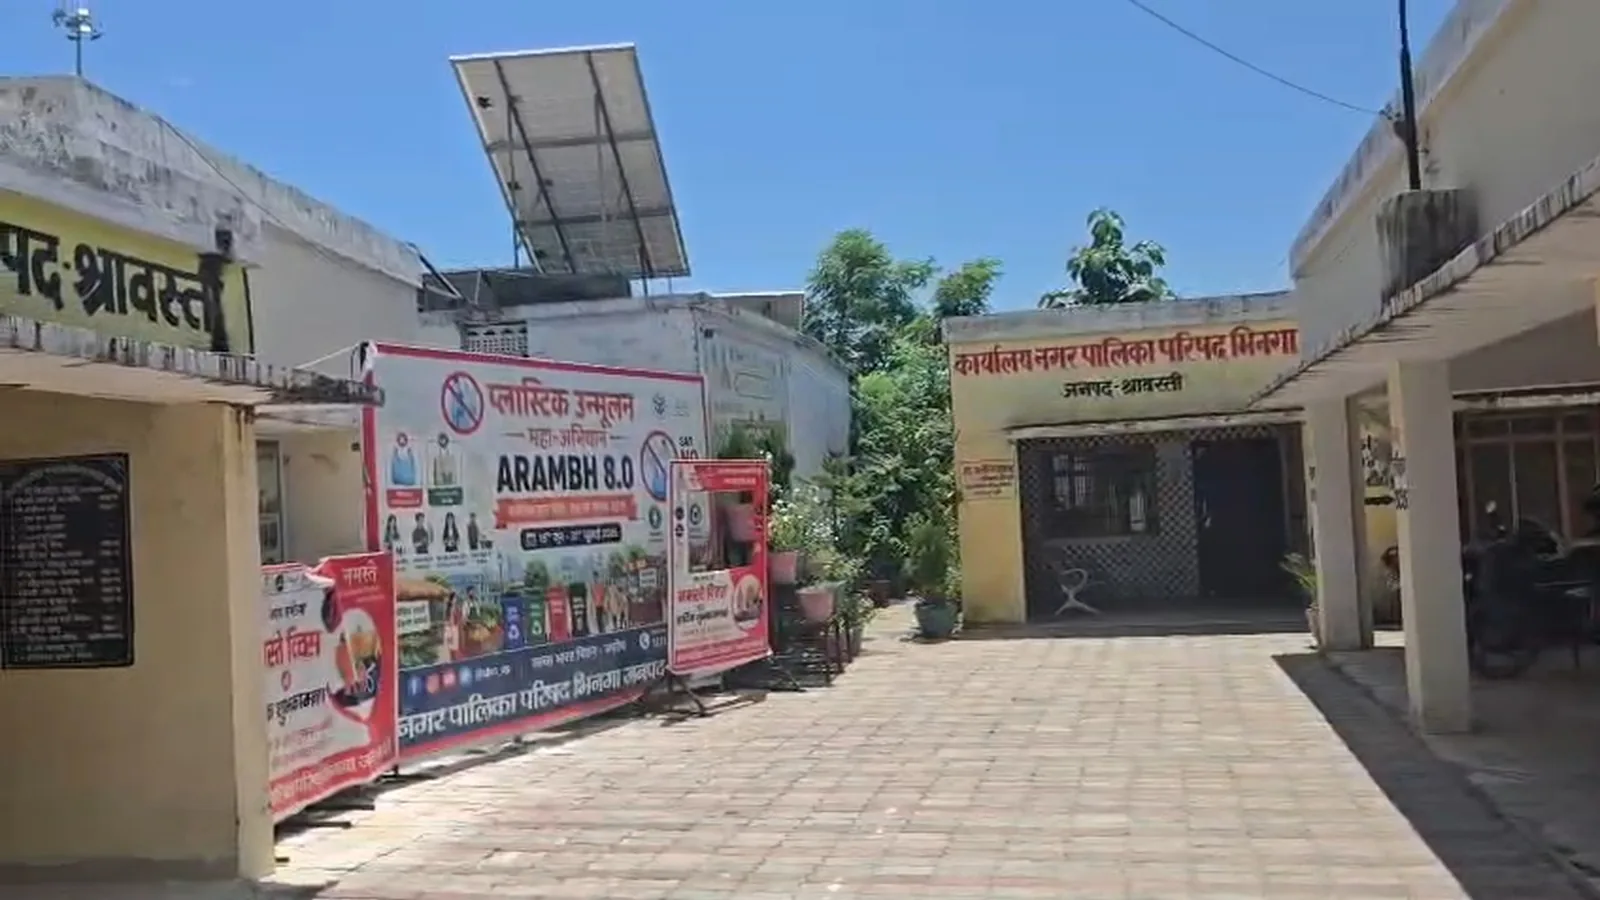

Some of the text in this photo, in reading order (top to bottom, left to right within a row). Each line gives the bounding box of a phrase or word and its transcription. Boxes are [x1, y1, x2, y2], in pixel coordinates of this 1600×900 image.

[954, 344, 1032, 376] कार्यालय
[1034, 346, 1077, 373] नगर
[1081, 337, 1154, 369] पालिका
[1230, 325, 1298, 359] भिनगा
[485, 377, 570, 418] प्लास्टिक
[573, 386, 635, 430] उन्मूलन
[497, 455, 599, 494] ARAMBH
[603, 454, 635, 491] 8.0
[341, 560, 378, 587] नमस्ते
[398, 705, 447, 741] नगर
[448, 693, 518, 729] पालिका
[572, 670, 622, 700] भिनगा
